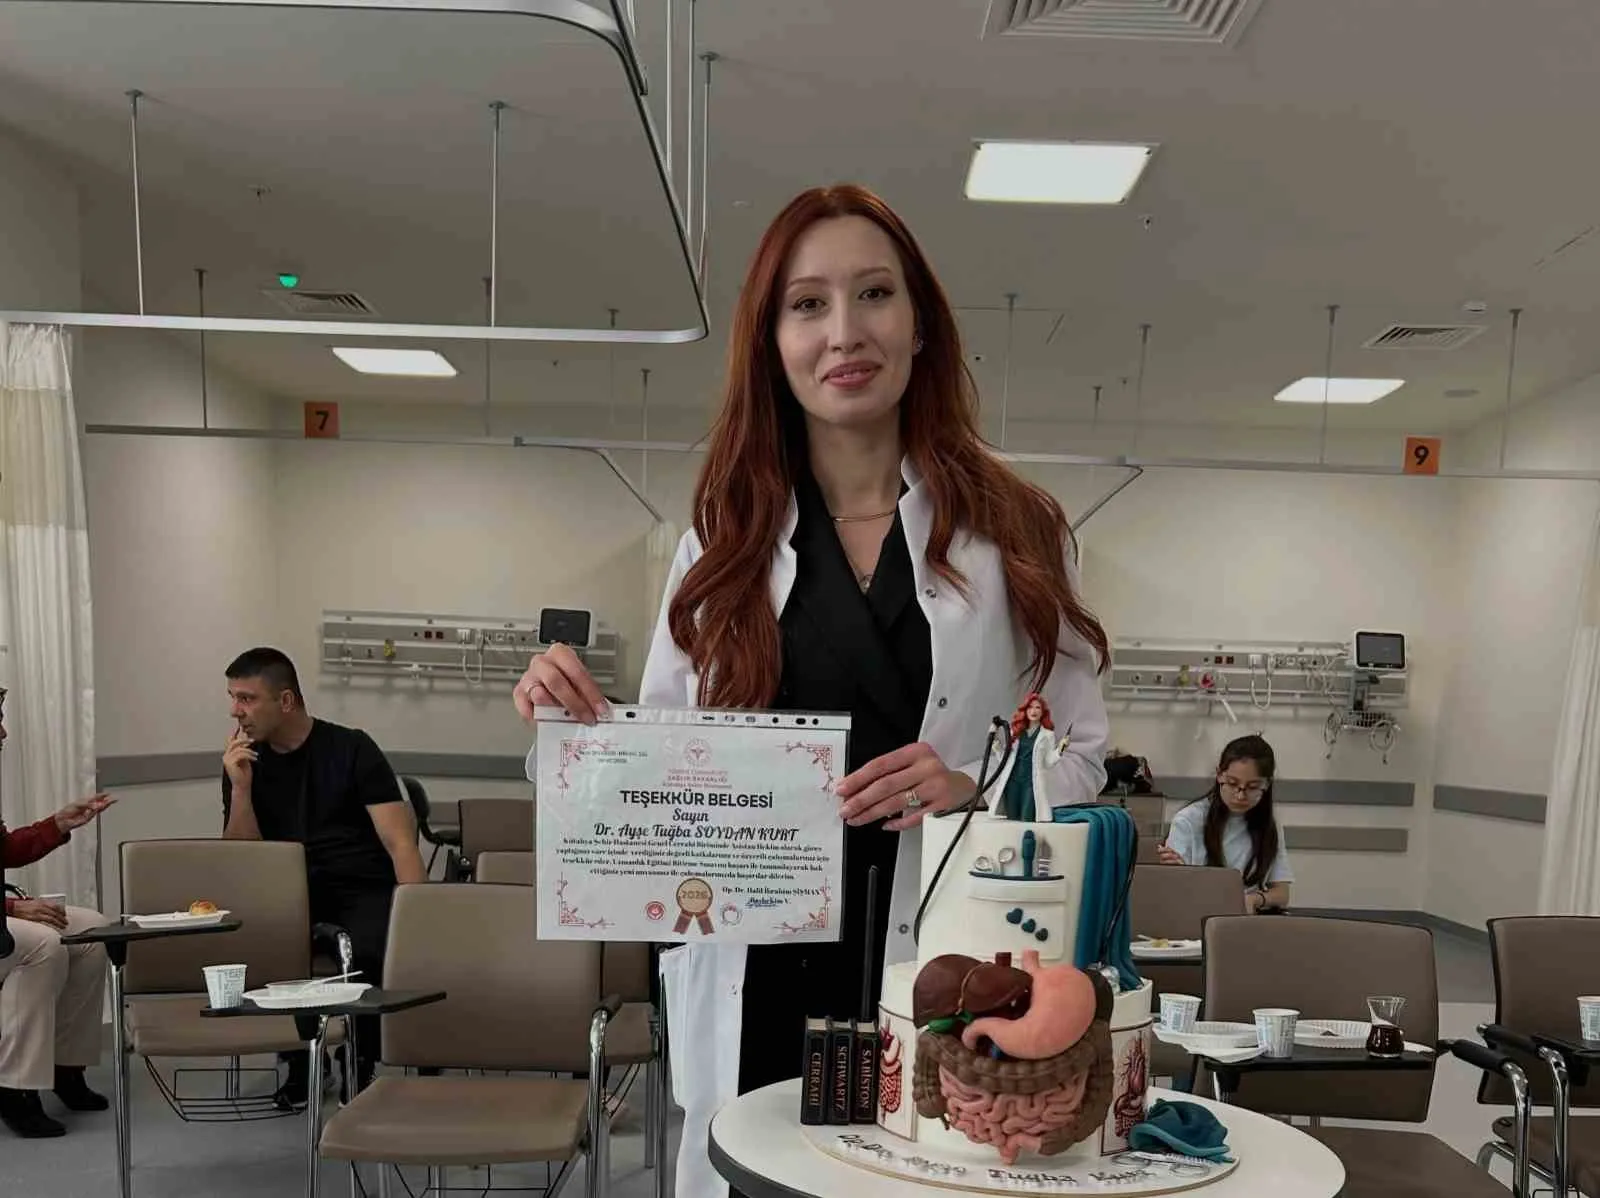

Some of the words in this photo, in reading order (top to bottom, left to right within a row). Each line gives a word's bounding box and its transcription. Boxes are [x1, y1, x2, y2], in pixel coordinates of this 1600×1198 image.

[316, 411, 329, 430] 7
[1414, 445, 1429, 465] 9
[619, 789, 705, 808] TEŞEKKÜR
[708, 791, 774, 808] BELGESİ
[672, 808, 709, 825] Sayın
[594, 822, 615, 837] Dr.
[617, 823, 651, 840] Ayşe
[653, 824, 691, 841] Tuğba
[694, 825, 755, 842] SOYDAN
[757, 828, 800, 842] KURT
[834, 1045, 849, 1112] SCHWARTZ
